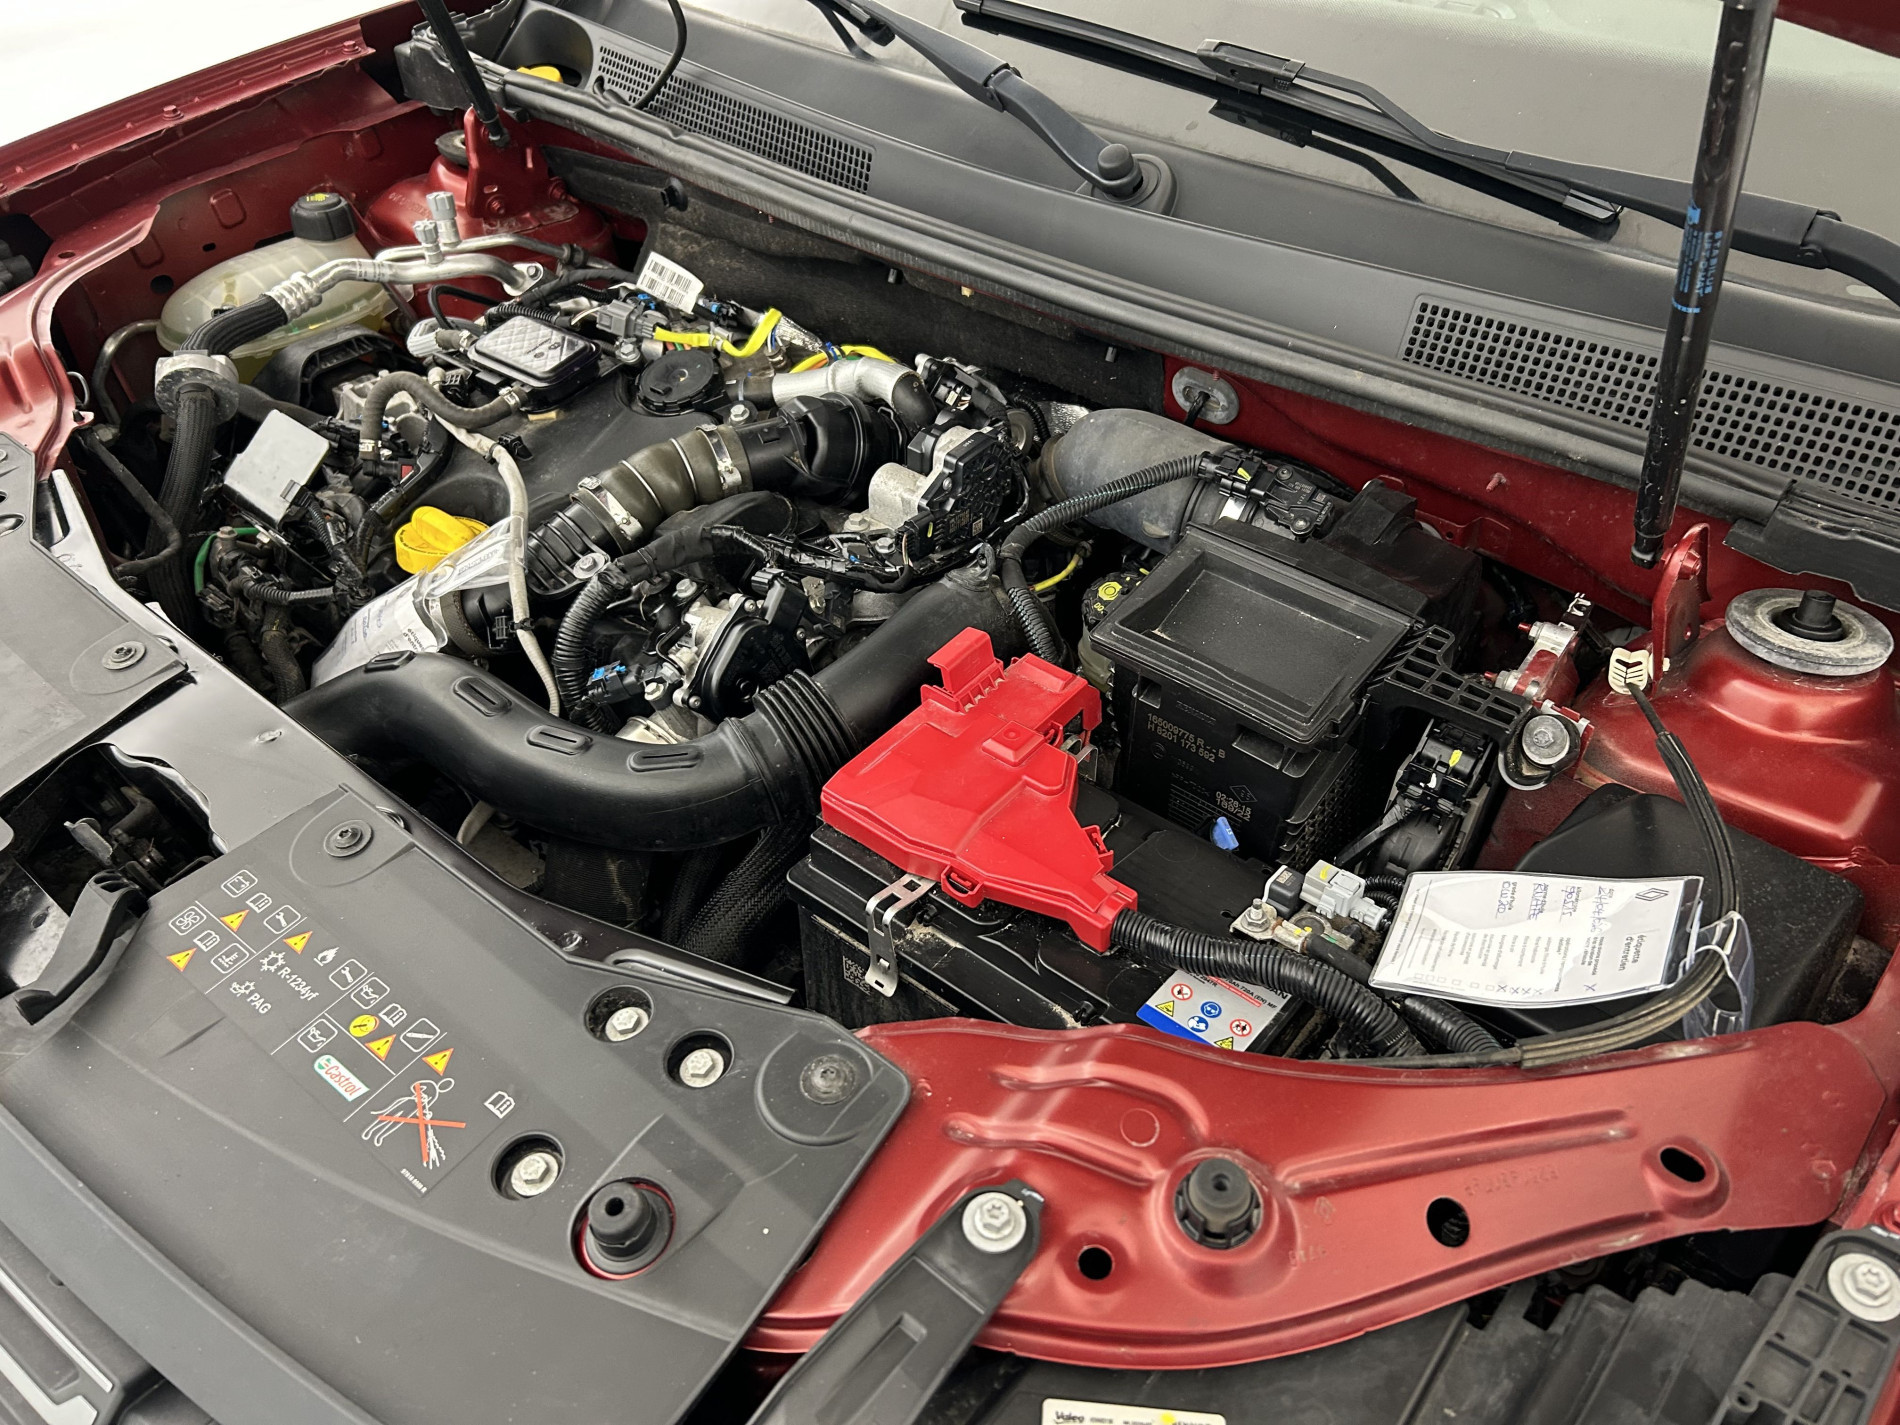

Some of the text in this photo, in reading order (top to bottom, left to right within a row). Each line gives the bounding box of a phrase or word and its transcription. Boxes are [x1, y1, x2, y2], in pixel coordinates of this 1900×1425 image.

[1705, 230, 1723, 293] STABILUS
[1147, 713, 1195, 742] 165009775
[1197, 738, 1205, 748] R
[1218, 749, 1225, 759] B
[1147, 722, 1155, 732] H
[1181, 739, 1196, 753] 173
[1199, 749, 1216, 763] 592
[1508, 896, 1516, 911] d'huile
[1618, 936, 1634, 971] d'entretien
[1632, 935, 1646, 964] étiquette
[278, 966, 319, 1001] R-1234yf
[1254, 993, 1267, 1005] (EN)
[247, 992, 272, 1015] PAG
[324, 1064, 362, 1097] Castrol
[1055, 1411, 1084, 1422] Valeo
